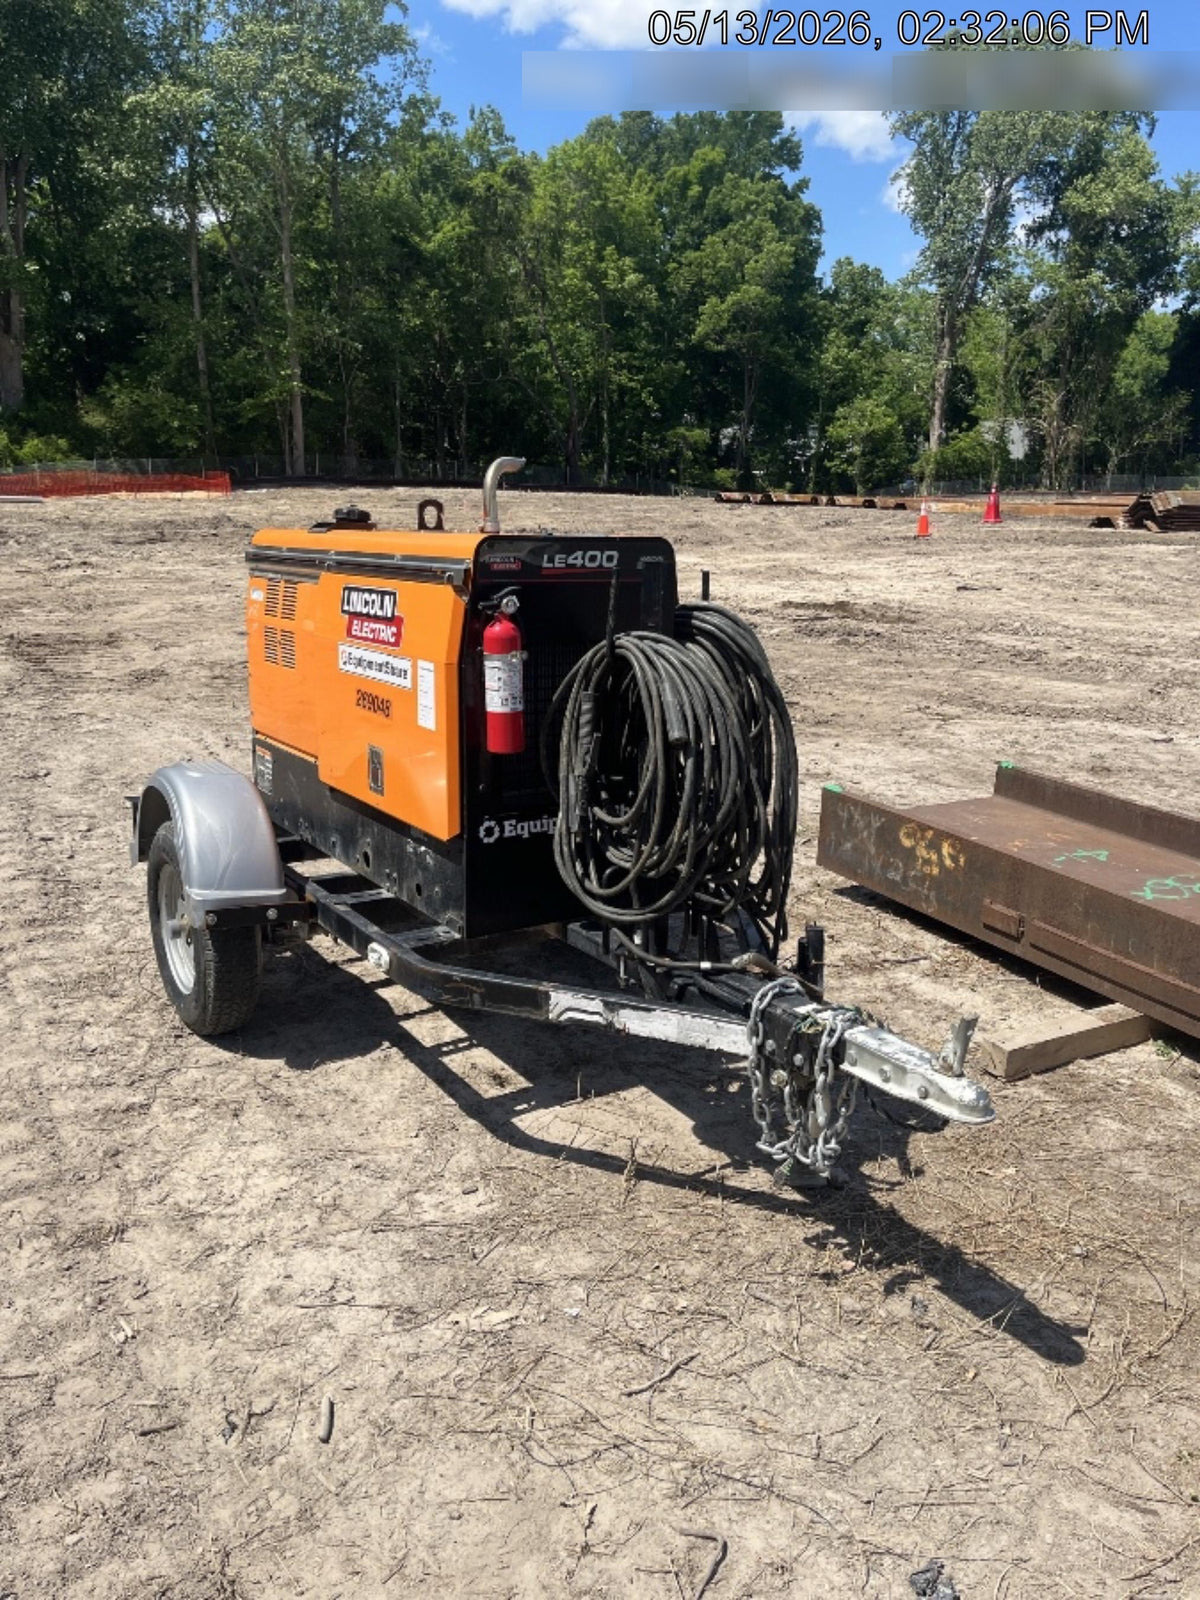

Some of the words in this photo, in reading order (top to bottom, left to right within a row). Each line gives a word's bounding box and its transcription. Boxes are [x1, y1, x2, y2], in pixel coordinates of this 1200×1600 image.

[542, 550, 619, 568] LE400
[343, 590, 394, 617] LINCOLN
[351, 620, 397, 642] ELECTRIC
